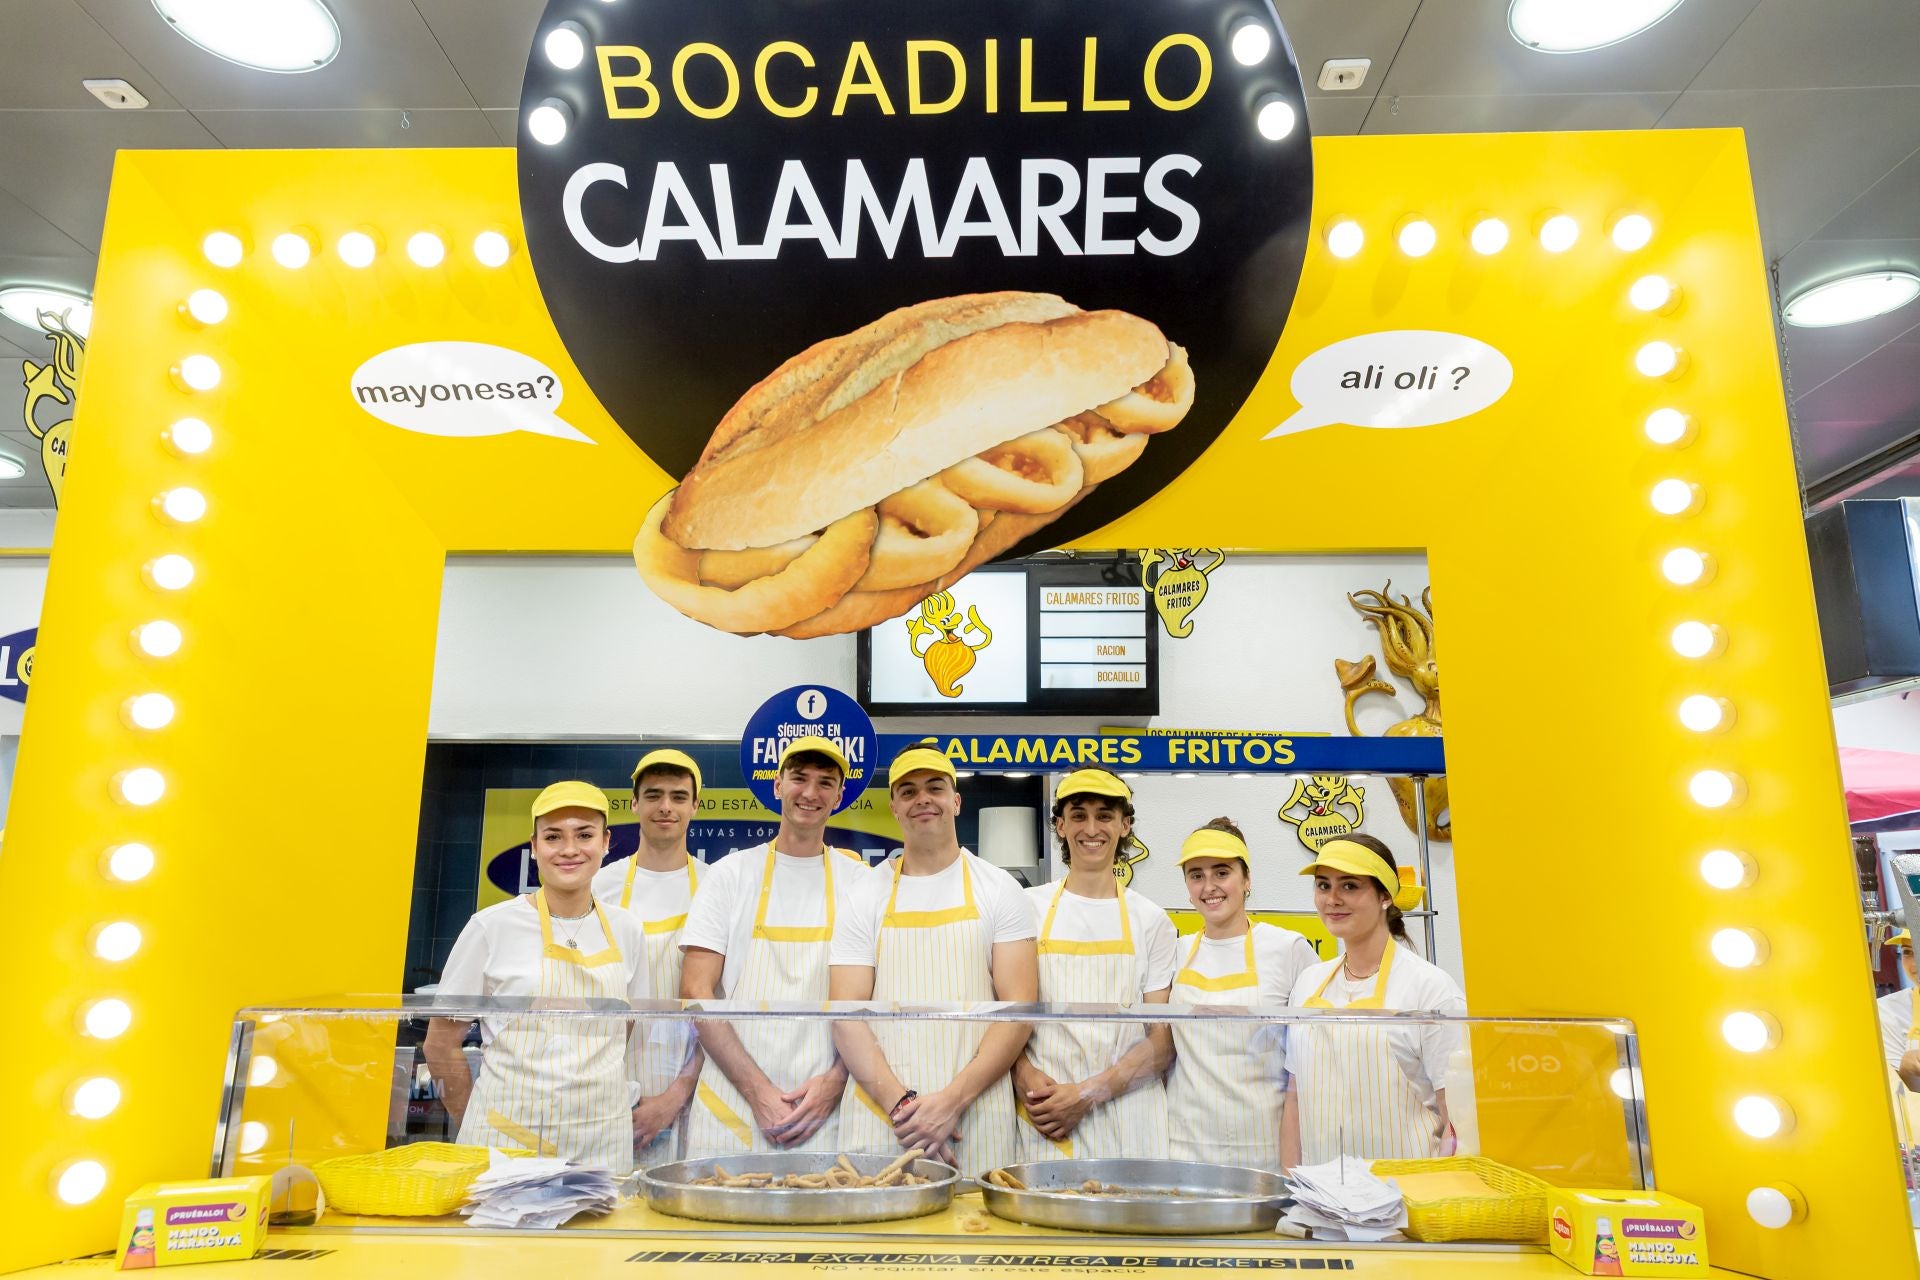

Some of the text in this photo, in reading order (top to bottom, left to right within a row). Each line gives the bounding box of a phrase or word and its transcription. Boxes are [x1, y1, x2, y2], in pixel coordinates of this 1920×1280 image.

[595, 32, 1213, 120] BOCADILLO
[562, 153, 1203, 264] CALAMARES
[1340, 364, 1471, 391] ali oli ?
[356, 375, 555, 408] mayonesa?
[1158, 580, 1200, 597] CALAMARES
[1046, 591, 1140, 606] CALAMARES FRITOS
[1166, 596, 1192, 610] FRITOS
[1097, 645, 1126, 656] RACION
[1097, 671, 1140, 683] BOCADILLO
[777, 722, 841, 737] SÍGUENOS EN
[920, 737, 1296, 765] ALAMARES FRITOS
[722, 796, 759, 810] ESTÁ
[1305, 824, 1347, 837] CALAMARES
[168, 1226, 220, 1240] MANGO
[167, 1235, 242, 1250] MARACUYÁ
[1628, 1242, 1676, 1253] MANGO
[699, 1252, 1287, 1269] BARRA EXCLUSIVA ENTREGA DE TICKETS
[1629, 1252, 1699, 1265] MARACUYÁ
[1059, 1267, 1147, 1275] espacio
